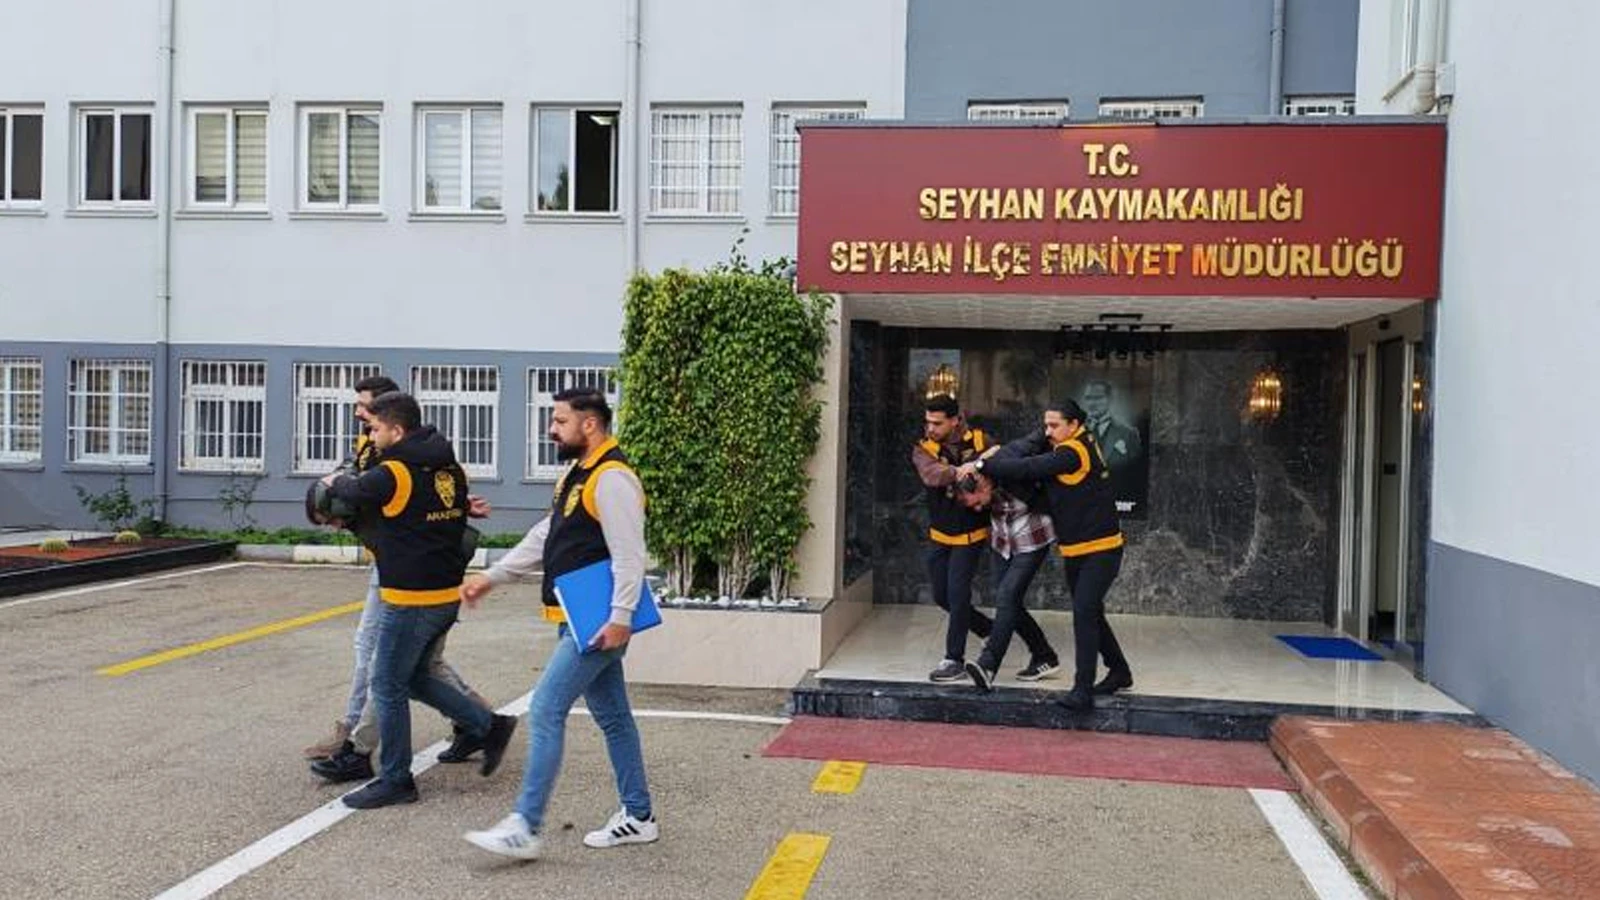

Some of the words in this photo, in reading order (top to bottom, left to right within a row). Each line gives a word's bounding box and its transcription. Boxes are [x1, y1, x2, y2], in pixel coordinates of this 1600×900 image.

[1083, 143, 1138, 176] T.C.
[919, 187, 1044, 220] SEYHAN
[1054, 183, 1304, 221] KAYMAKAMLIĞI
[830, 240, 953, 274] SEYHAN
[962, 235, 1031, 281] İLÇE
[1041, 235, 1184, 276] EMNİYET
[1191, 237, 1403, 278] MÜDÜRLÜĞÜ
